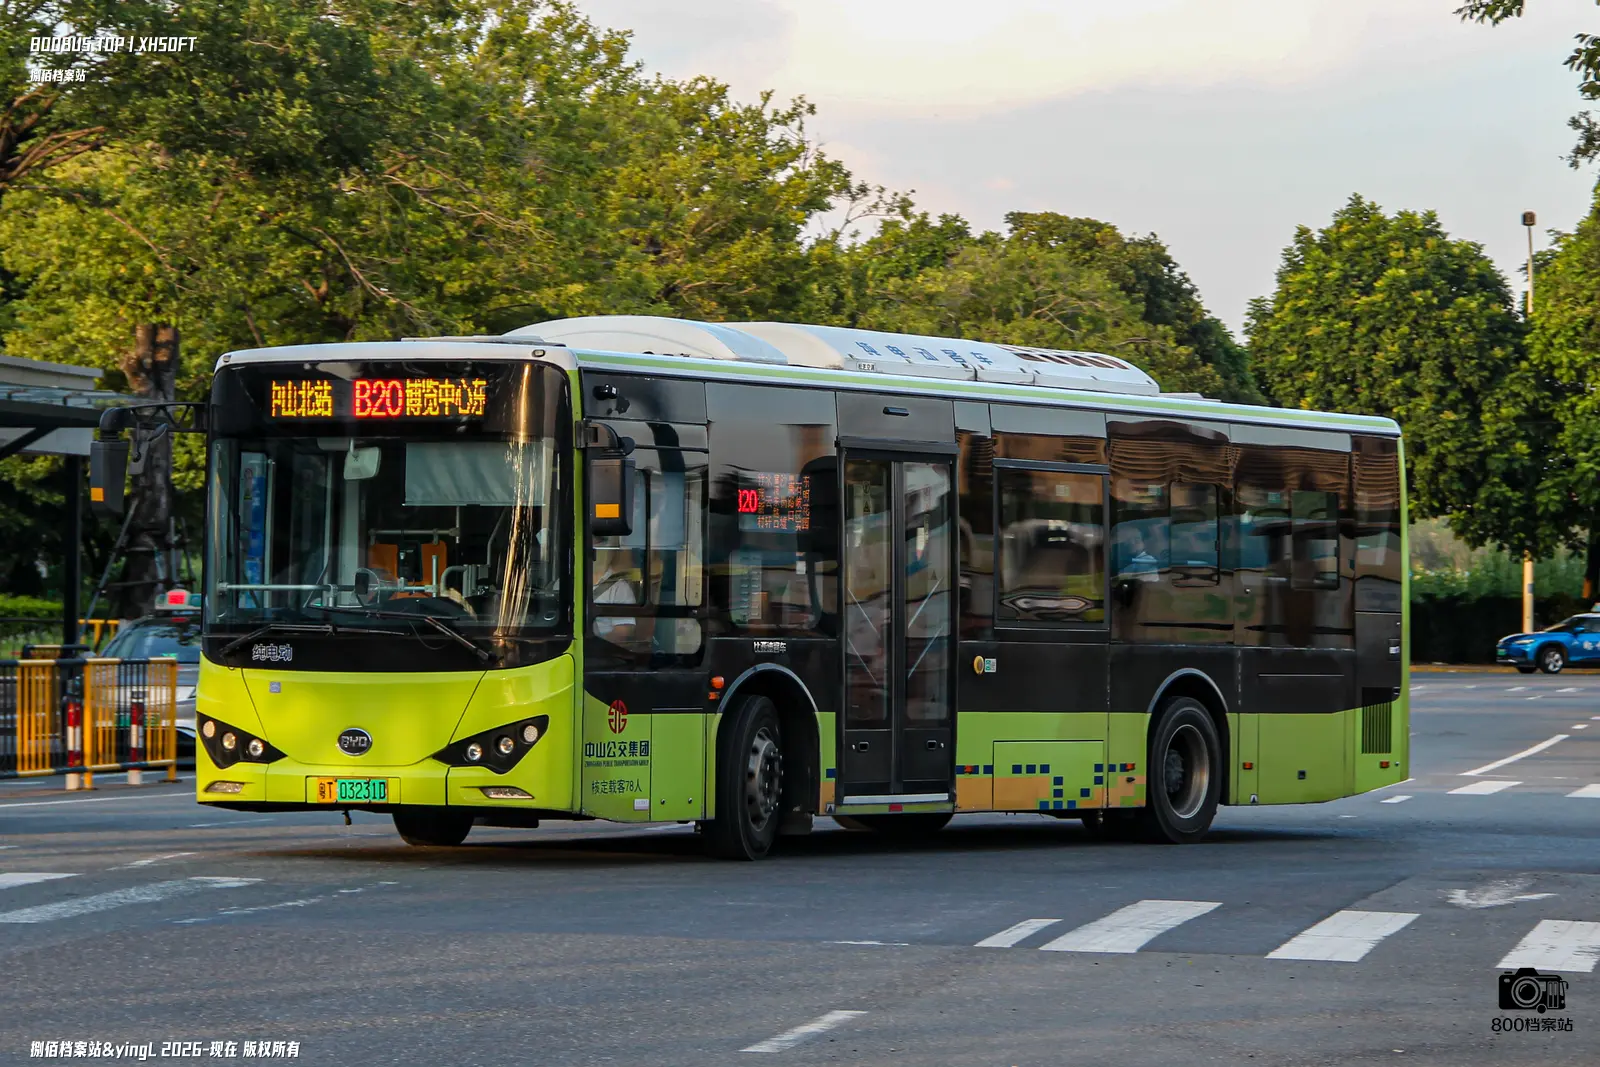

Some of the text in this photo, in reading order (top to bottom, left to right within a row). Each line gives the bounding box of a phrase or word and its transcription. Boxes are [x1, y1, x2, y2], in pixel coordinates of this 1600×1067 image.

[354, 380, 403, 418] B20
[252, 643, 293, 662] 纯电动
[341, 736, 368, 748] BYD
[585, 740, 649, 758] 中山公交集团
[592, 779, 642, 794] 核定载客78人
